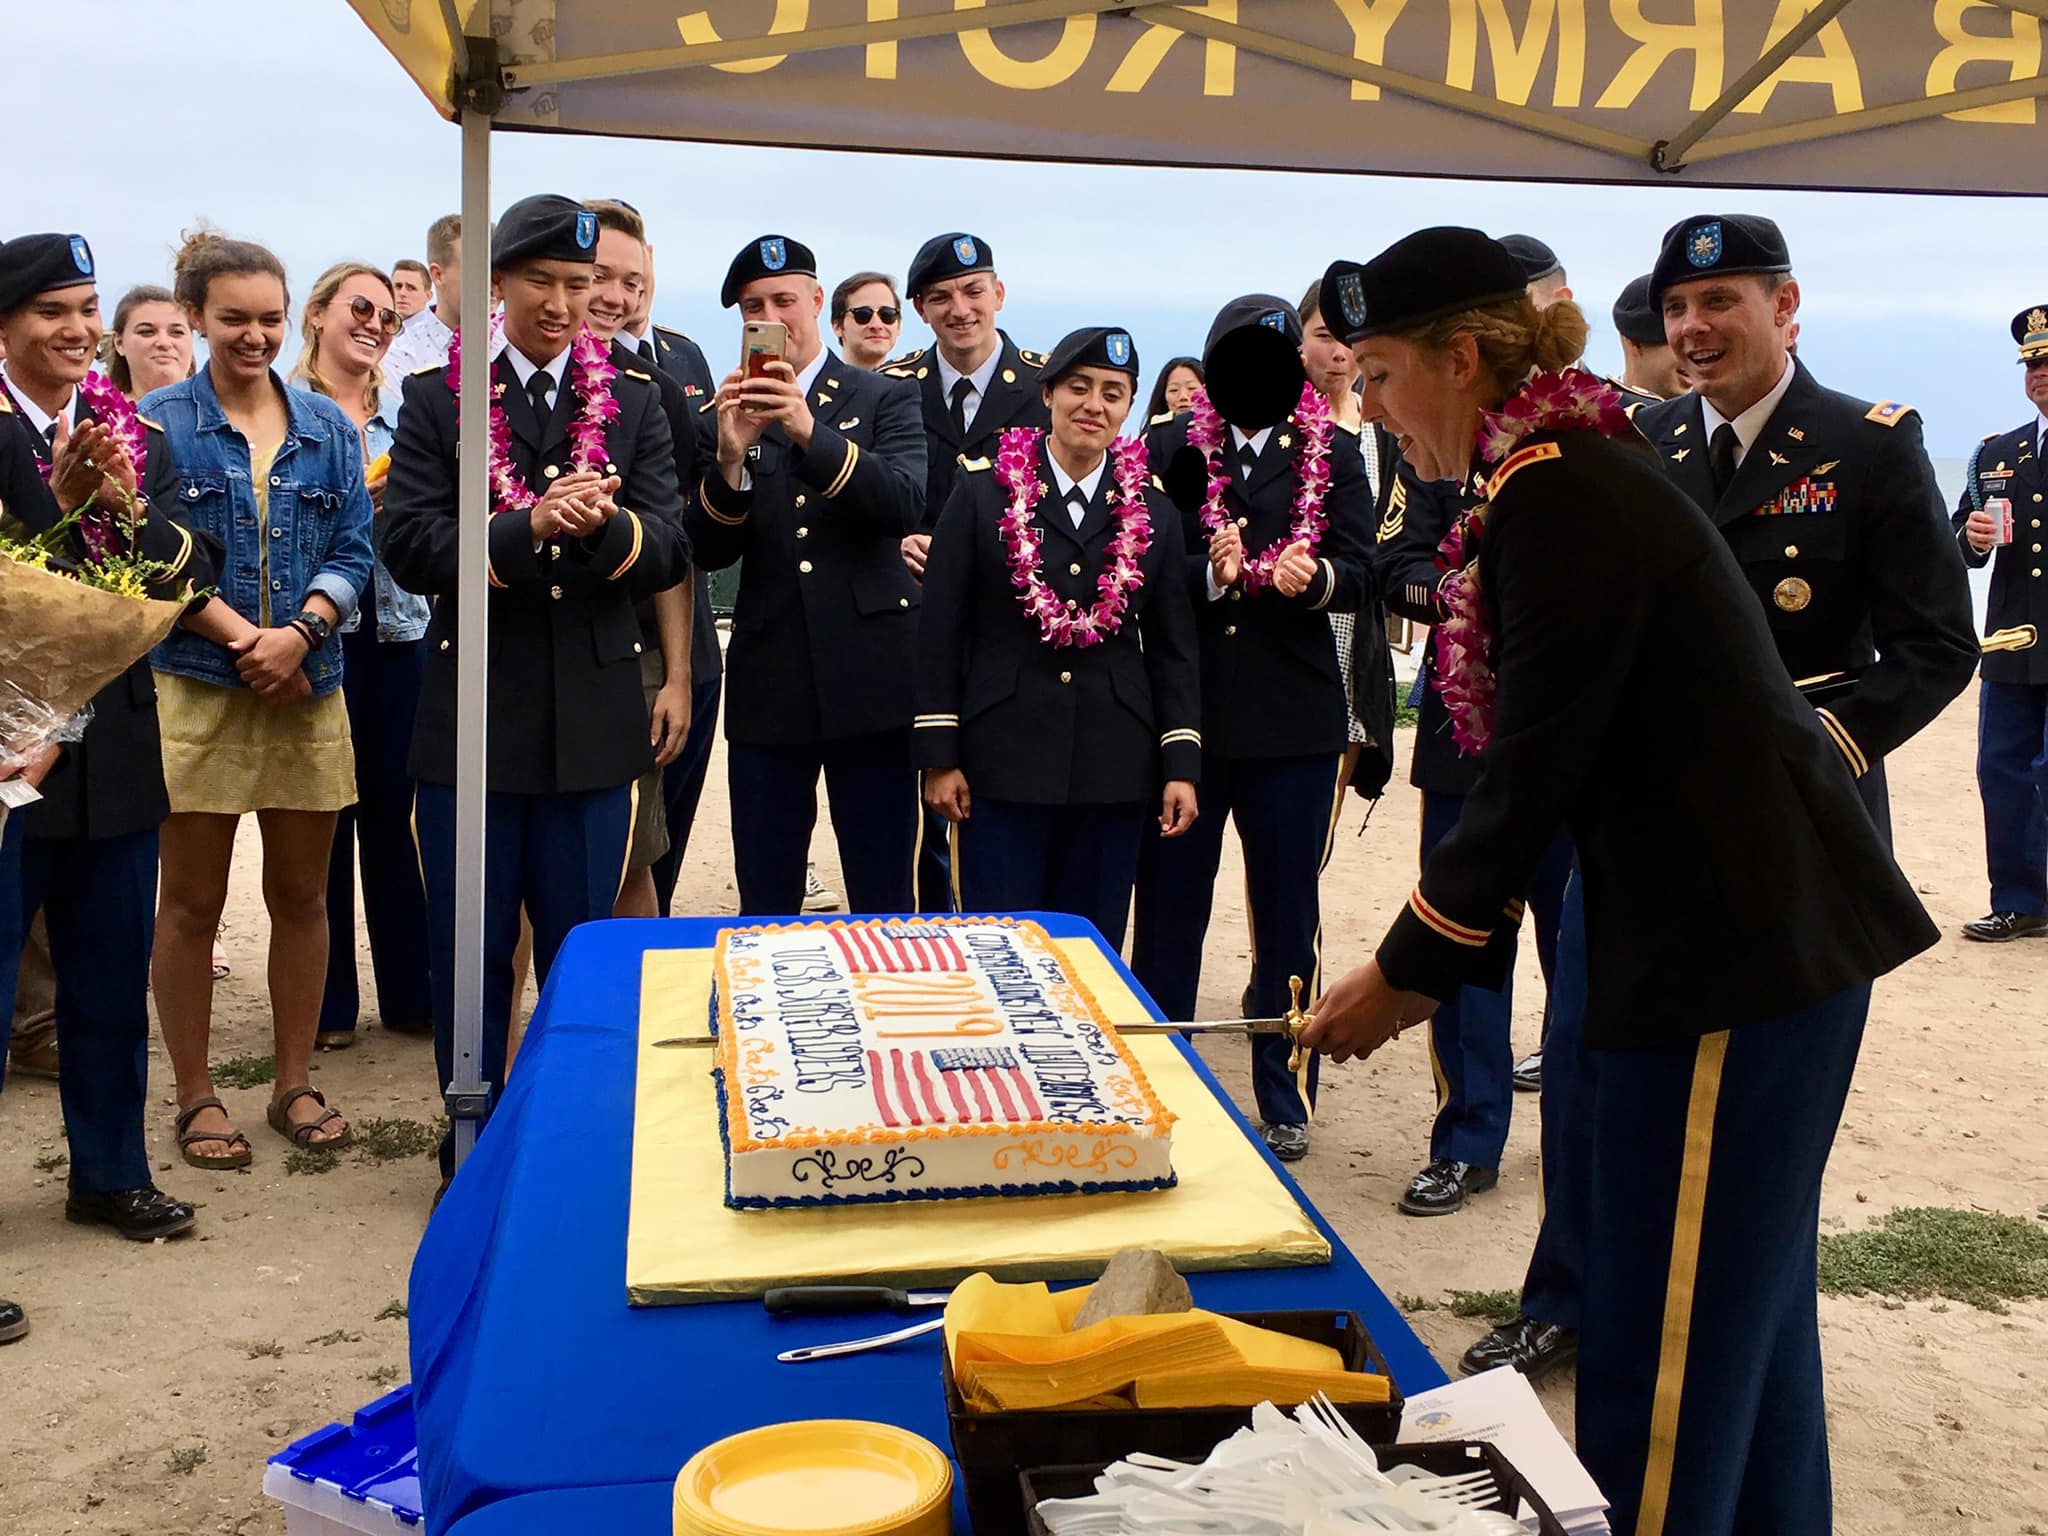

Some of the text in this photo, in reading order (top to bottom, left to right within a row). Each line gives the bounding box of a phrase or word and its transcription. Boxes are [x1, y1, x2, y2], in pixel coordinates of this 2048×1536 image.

[771, 945, 866, 1093] UCSB SURFRIDERS
[851, 973, 1004, 1039] 2019
[1004, 1009, 1074, 1040] NEW
